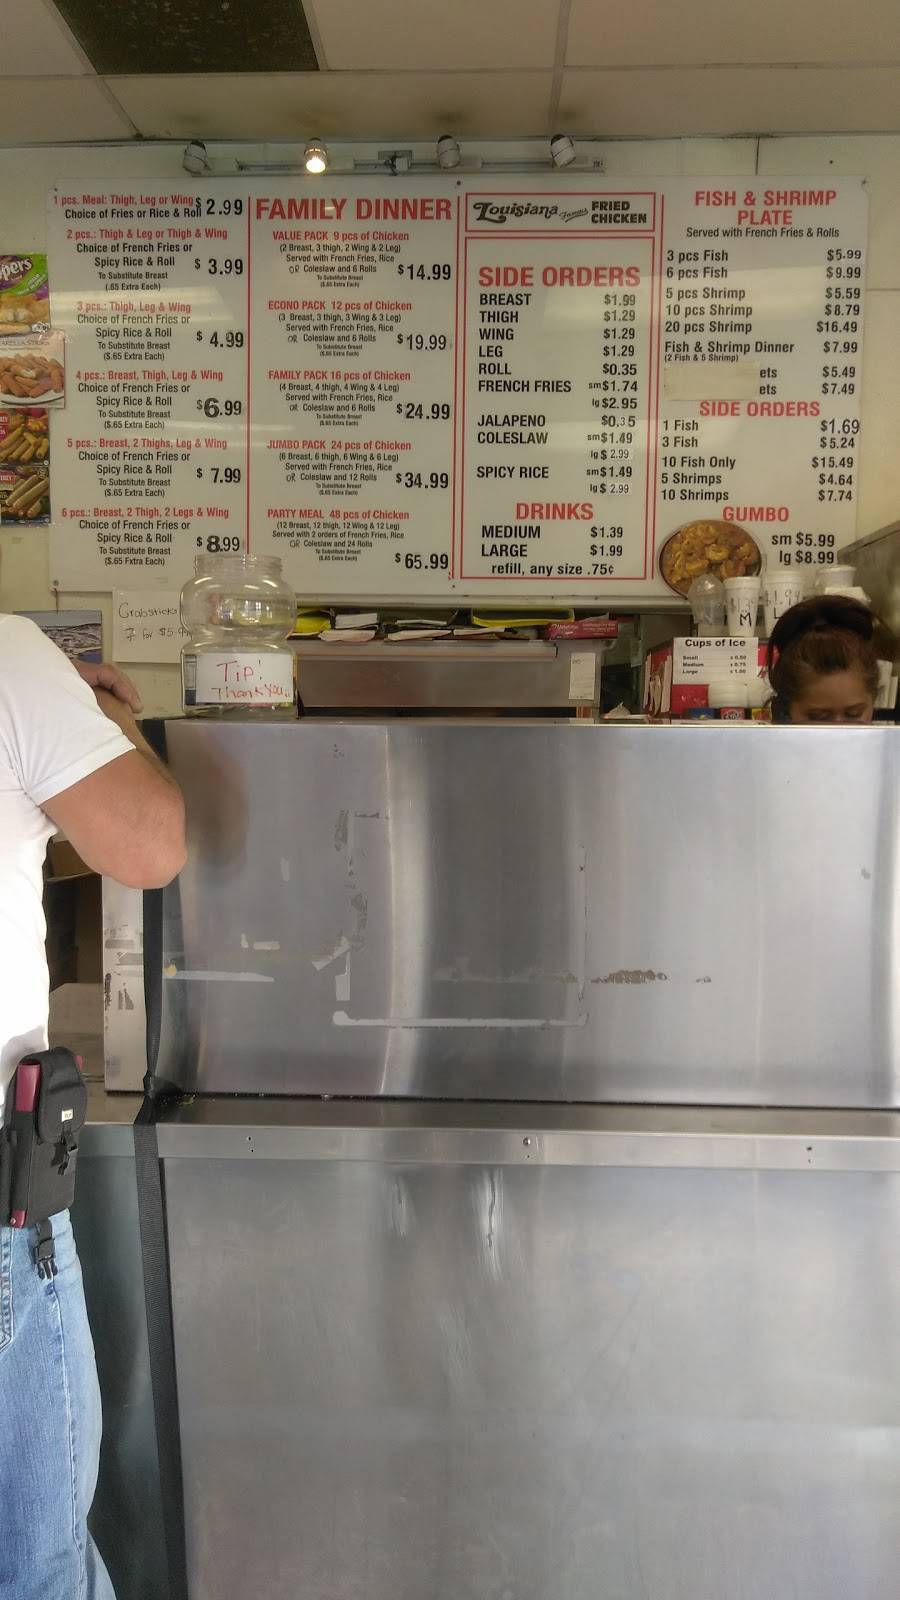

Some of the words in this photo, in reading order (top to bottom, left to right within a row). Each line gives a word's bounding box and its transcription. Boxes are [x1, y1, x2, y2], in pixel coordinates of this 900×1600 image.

[54, 195, 57, 205] 1
[61, 197, 80, 206] pcs.
[82, 195, 107, 205] Meal:
[110, 194, 137, 206] Thigh,
[140, 195, 157, 206] Leg
[160, 197, 169, 205] or
[172, 195, 193, 206] Wing
[695, 191, 736, 206] FISH
[744, 191, 756, 206] &
[763, 190, 836, 207] SHRIMP
[256, 198, 347, 220] FAMILY
[357, 198, 452, 220] DINNER
[592, 201, 630, 211] FRIED
[65, 209, 96, 219] Choice
[98, 209, 108, 218] of
[111, 208, 134, 218] Fries
[137, 210, 146, 218] or
[150, 208, 169, 218] Rice
[173, 208, 179, 217] &
[184, 208, 201, 218] Roll
[473, 202, 558, 224] Louisiana
[591, 213, 646, 224] CHICKEN
[737, 210, 793, 226] PLATE
[273, 231, 301, 242] VALUE
[304, 231, 329, 242] PACK
[334, 231, 341, 240] 9
[342, 233, 358, 242] pcs
[361, 231, 370, 241] of
[373, 231, 409, 242] Chicken
[686, 227, 719, 237] Served
[722, 227, 742, 237] with
[745, 227, 777, 238] French
[781, 227, 804, 237] Fries
[806, 227, 813, 237] &
[817, 227, 839, 237] Rolls
[77, 243, 108, 253] Choice
[111, 243, 119, 252] of
[123, 243, 154, 252] French
[157, 242, 180, 252] Fries
[183, 244, 192, 252] or
[95, 257, 120, 268] Spicy
[123, 256, 143, 266] Rice
[147, 256, 153, 266] &
[157, 256, 174, 266] Roll
[667, 250, 674, 261] 3
[679, 252, 699, 264] pcs
[703, 250, 728, 261] Fish
[827, 249, 861, 261] $5.99
[478, 267, 534, 288] SIDE
[542, 266, 640, 287] ORDERS
[667, 267, 673, 278] 6
[678, 269, 699, 280] pcs
[703, 267, 727, 278] Fish
[826, 266, 861, 279] $9.99
[480, 293, 532, 306] BREAST
[604, 294, 635, 306] $1.99
[479, 311, 518, 323] THIGH
[603, 310, 635, 322] $1.29
[479, 328, 514, 340] WING
[604, 328, 635, 340] $1.29
[665, 321, 680, 332] 20
[684, 323, 704, 335] pcs
[709, 321, 752, 335] Shrimp
[817, 321, 857, 333] $16.49
[479, 345, 503, 357] LEG
[603, 345, 634, 357] $1.29
[665, 341, 689, 352] Fish
[694, 341, 702, 352] &
[708, 341, 750, 354] Shrimp
[755, 341, 794, 352] Dinner
[824, 341, 858, 353] $7.99
[479, 363, 512, 375] ROLL
[603, 363, 637, 375] $0.35
[823, 366, 855, 378] $5.49
[479, 380, 529, 392] FRENCH
[535, 380, 571, 392] FRIES
[699, 401, 741, 417] SIDE
[747, 400, 820, 417] ORDERS
[478, 415, 545, 427] JALAPENO
[663, 420, 668, 431] 1
[674, 420, 698, 431] Fish
[821, 418, 860, 435] $1.69
[478, 432, 548, 445] COLESLAW
[662, 436, 669, 447] 3
[674, 436, 698, 447] Fish
[820, 437, 855, 449] $5.24
[267, 440, 299, 450] JUMBO
[302, 440, 326, 452] PACK
[331, 440, 342, 449] 24
[345, 442, 360, 452] pcs
[364, 440, 372, 450] of
[375, 440, 411, 452] Chicken
[662, 456, 676, 467] 10
[681, 456, 705, 467] Fish
[710, 456, 736, 470] Only
[812, 456, 853, 469] $15.49
[477, 466, 515, 478] SPICY
[520, 466, 549, 478] RICE
[661, 473, 668, 484] 5
[673, 473, 722, 486] Shrimps
[819, 473, 852, 485] $4.64
[662, 489, 675, 500] 10
[680, 489, 728, 503] Shrimps
[818, 490, 852, 502] $7.74
[268, 508, 296, 519] PARTY
[299, 509, 324, 521] MEAL
[329, 510, 340, 520] 48
[343, 512, 359, 521] pcs
[361, 510, 371, 520] of
[373, 510, 409, 521] Chicken
[516, 503, 593, 520] DRINKS
[722, 506, 789, 523] GUMBO
[482, 525, 540, 538] MEDIUM
[591, 526, 623, 538] $1.39
[772, 535, 792, 545] sm
[796, 533, 834, 547] $5.99
[482, 544, 527, 557] LARGE
[590, 544, 622, 556] $1.99
[779, 550, 791, 566] lg
[795, 551, 835, 565] $8.99
[492, 563, 524, 576] refill,
[530, 565, 553, 576] any
[557, 563, 582, 575] size
[740, 612, 752, 627] M
[685, 639, 712, 648] Cups
[715, 639, 726, 647] of
[729, 639, 746, 647] Ice
